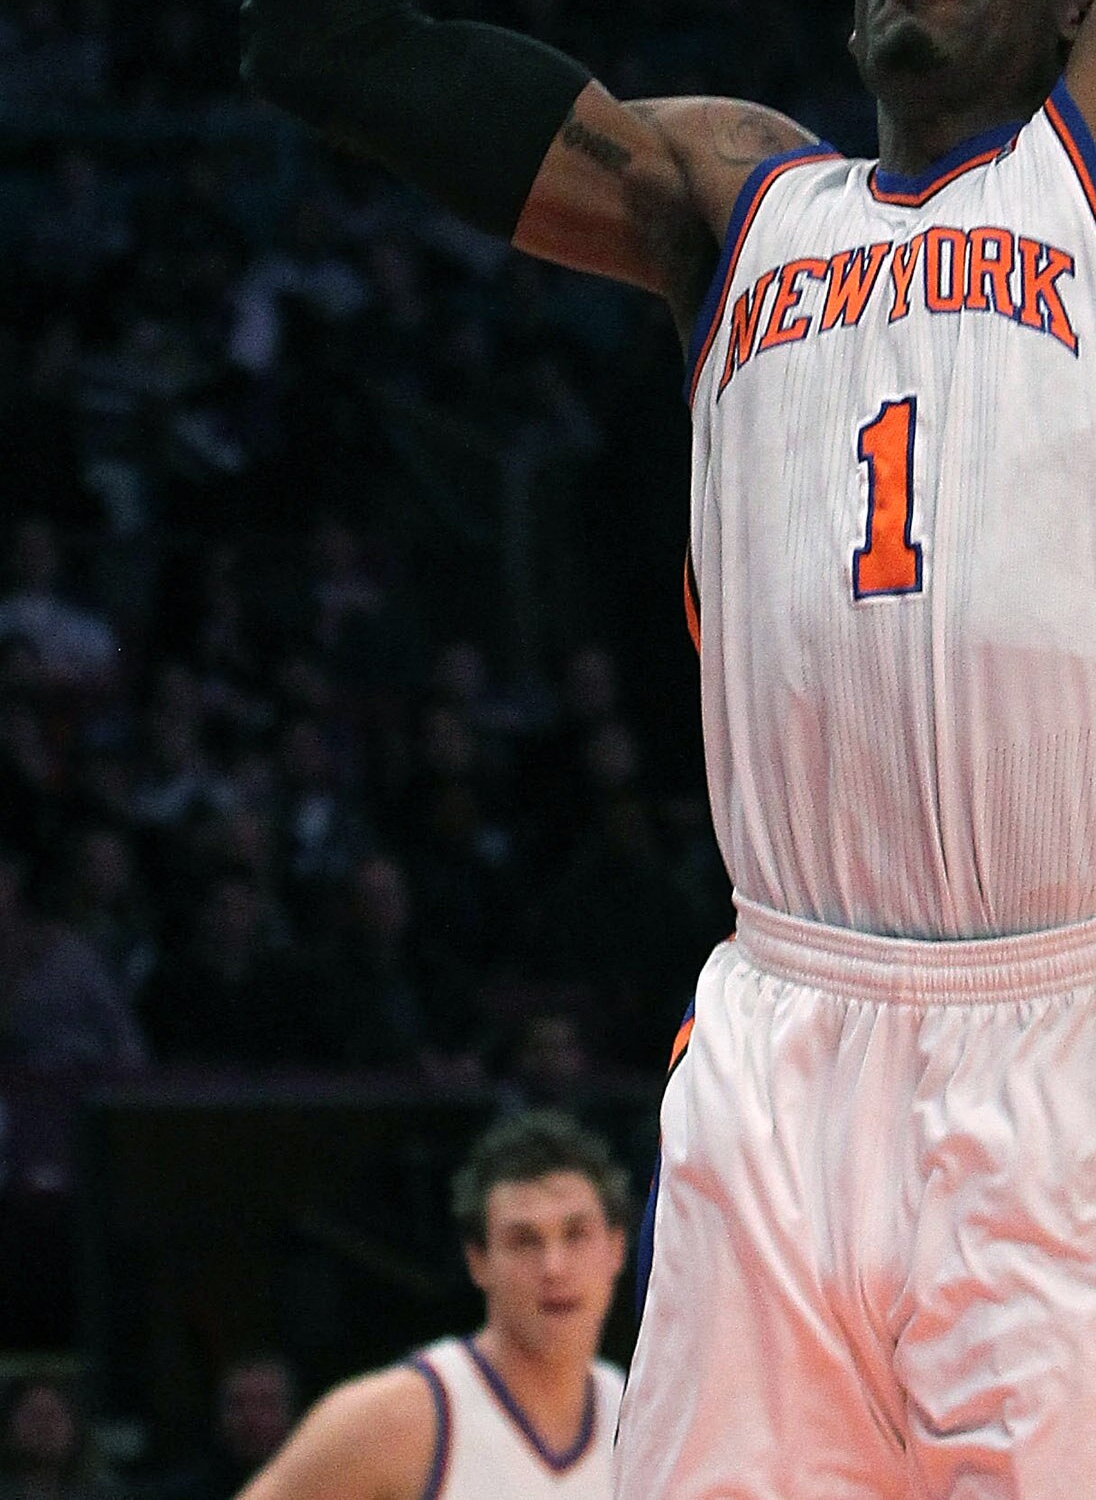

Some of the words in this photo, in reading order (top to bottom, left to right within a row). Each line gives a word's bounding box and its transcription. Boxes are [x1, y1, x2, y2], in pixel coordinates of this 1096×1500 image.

[716, 240, 894, 404] NEW
[887, 226, 1080, 359] YORK
[853, 396, 923, 600] 1
